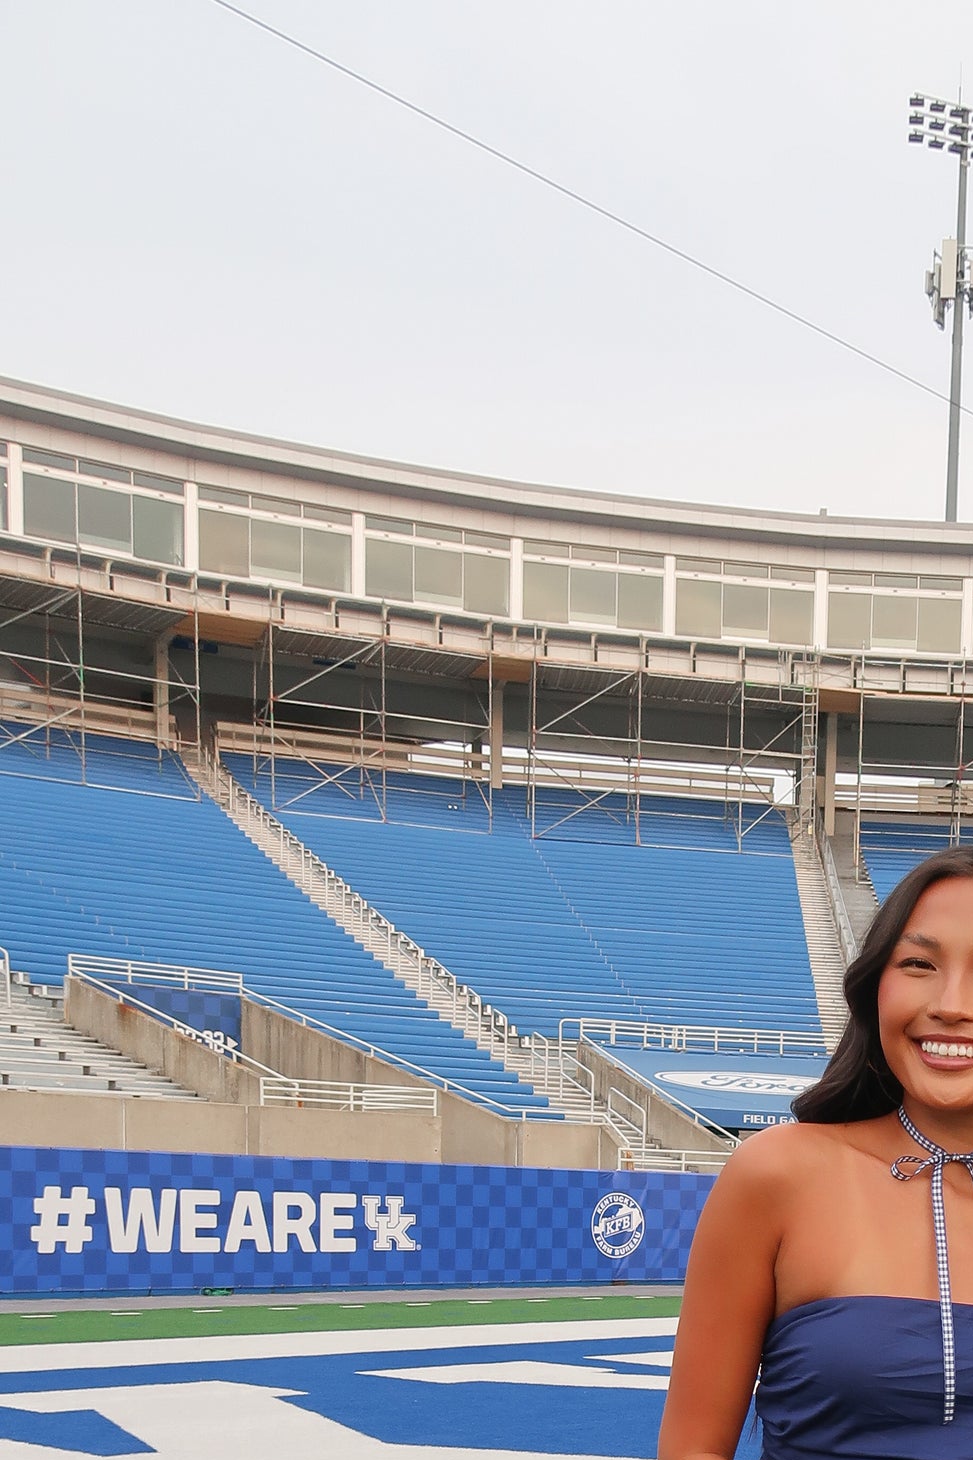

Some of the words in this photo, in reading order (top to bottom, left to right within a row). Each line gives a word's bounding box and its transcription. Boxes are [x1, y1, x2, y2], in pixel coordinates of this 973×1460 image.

[743, 1114, 776, 1125] FIELD
[779, 1115, 797, 1125] GA
[596, 1195, 635, 1215] KENTUCKY
[30, 1186, 357, 1254] #WEARE
[606, 1216, 631, 1236] KFB
[596, 1235, 613, 1255] FARM
[614, 1231, 641, 1256] BUREAU
